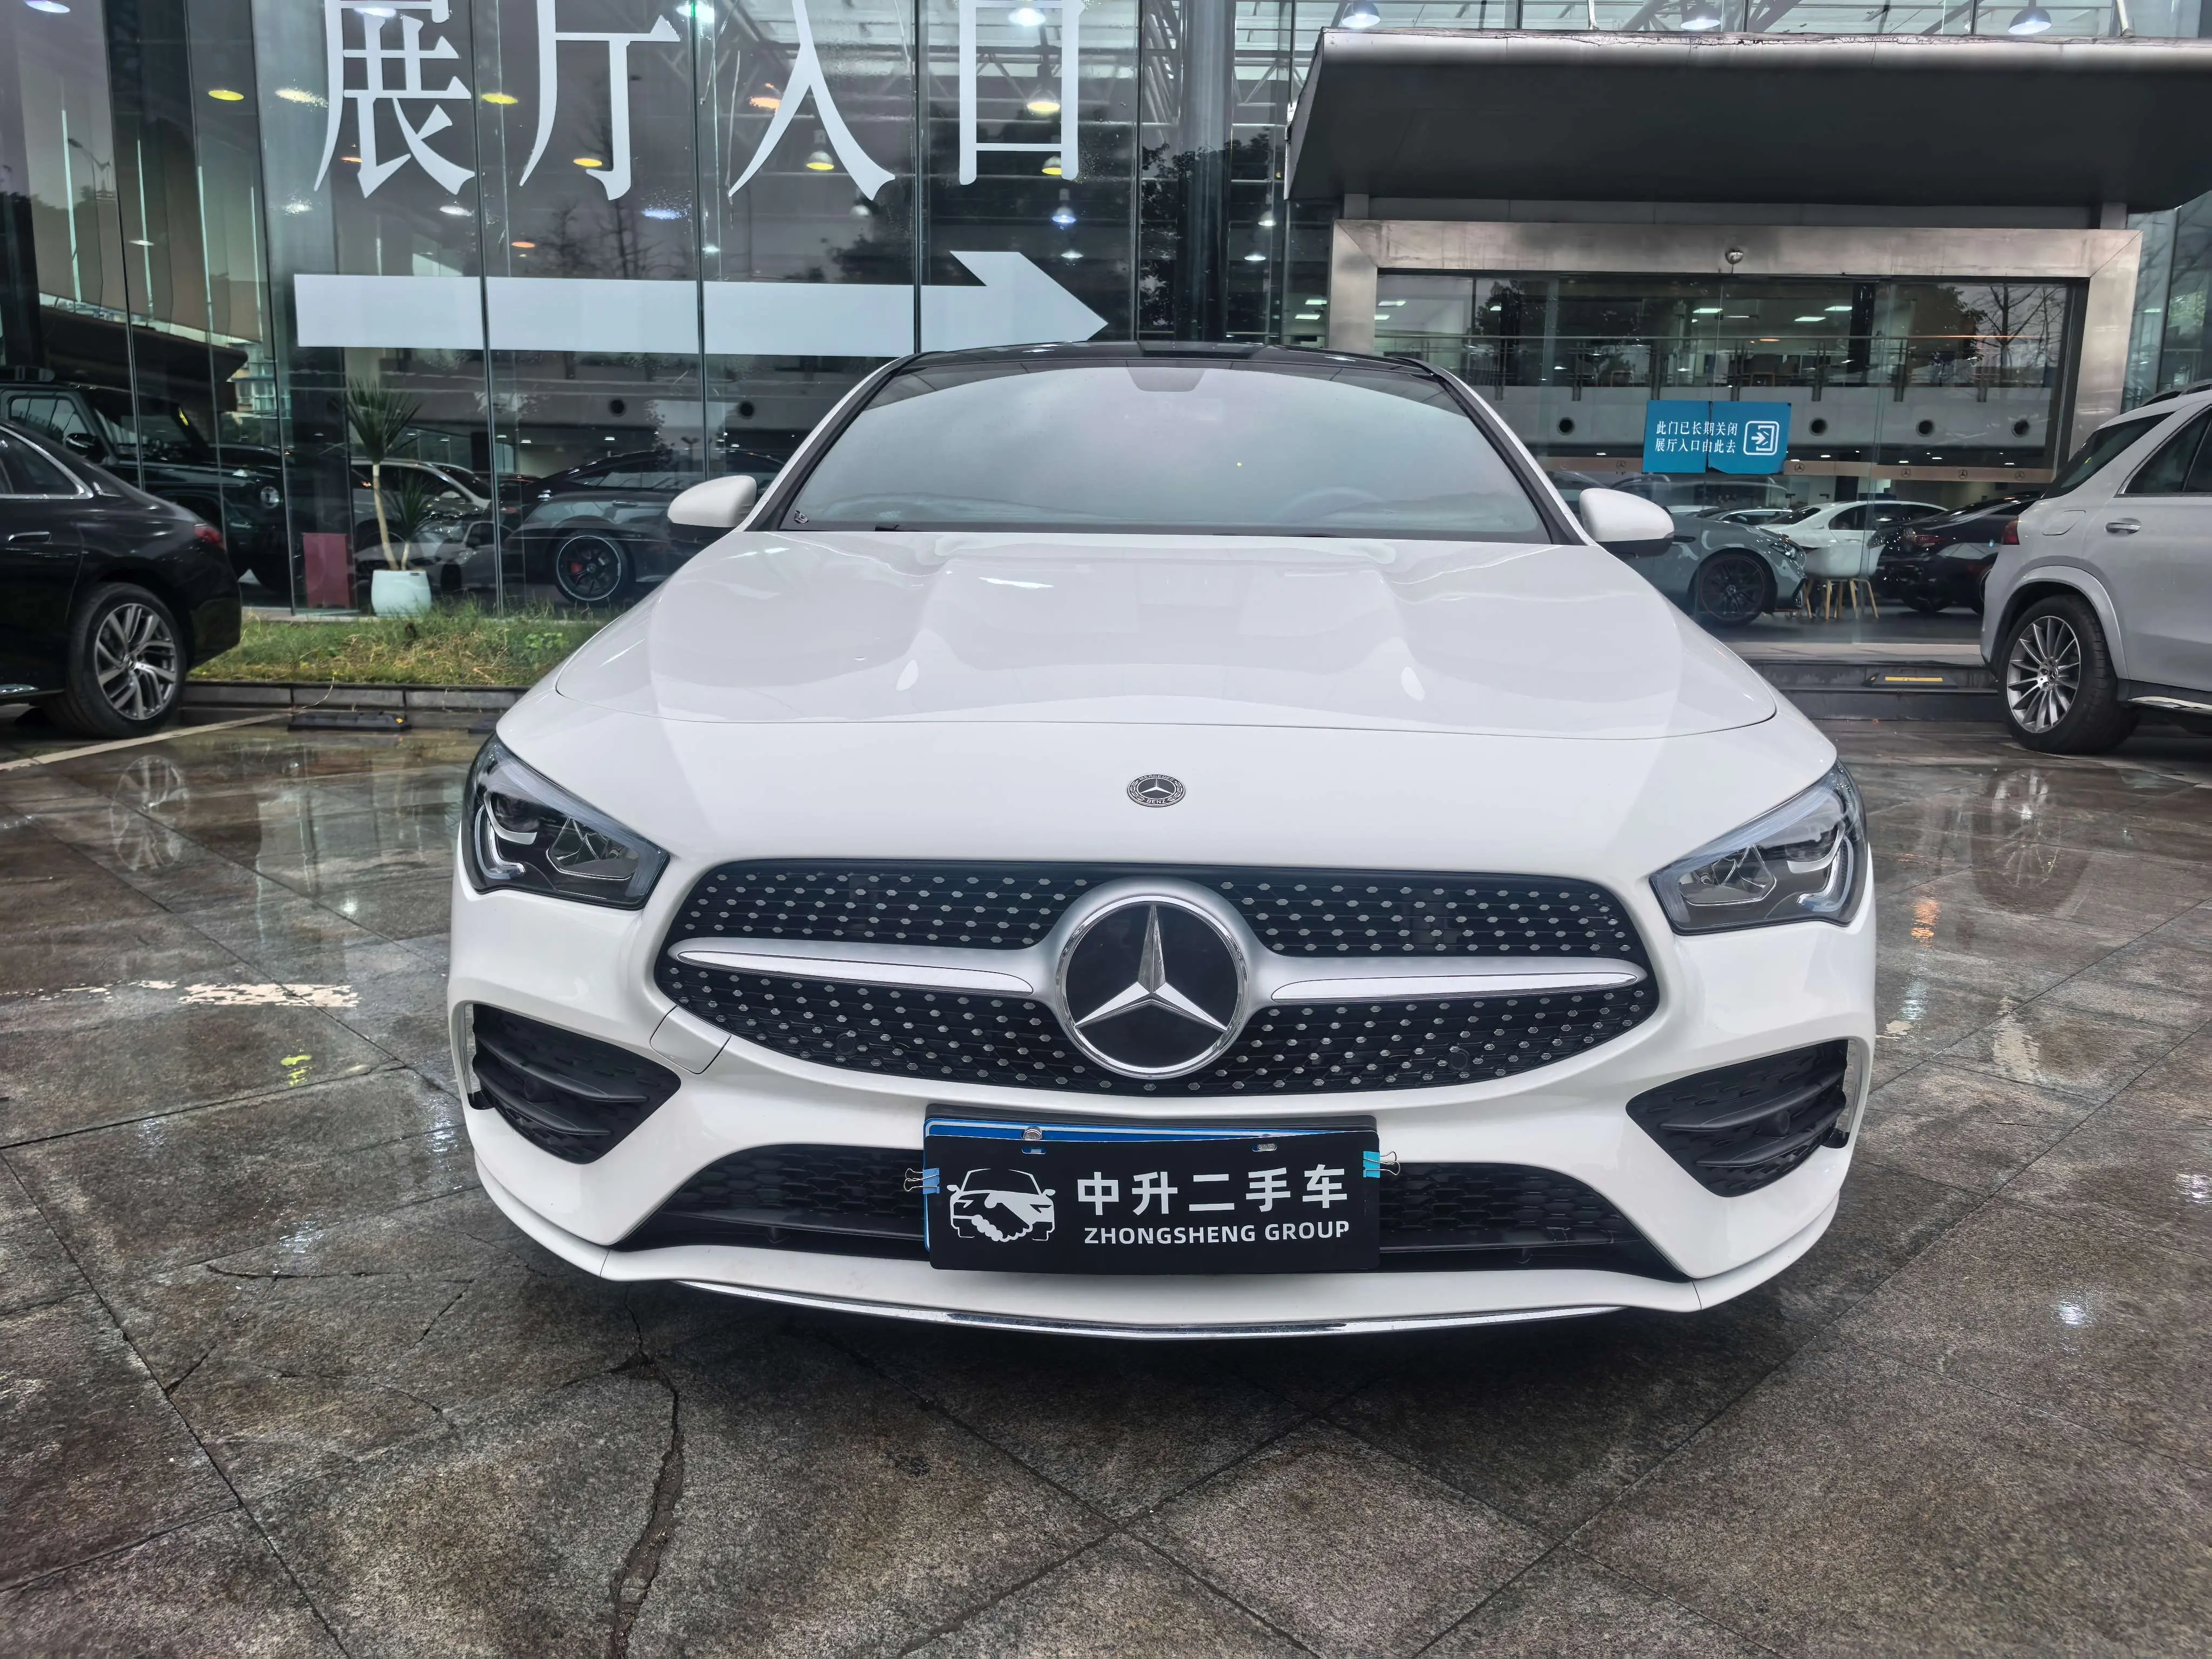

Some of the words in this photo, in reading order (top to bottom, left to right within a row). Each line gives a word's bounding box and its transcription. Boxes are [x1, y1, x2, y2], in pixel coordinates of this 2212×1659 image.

[314, 0, 1085, 201] 展厅入口
[1656, 421, 1738, 436] 此门已长期关闭
[1655, 438, 1736, 453] 展厅入口由此去
[1077, 1164, 1347, 1216] 中升二手车
[1084, 1225, 1256, 1244] ZHONGSHENG
[1265, 1220, 1349, 1240] GROUP
